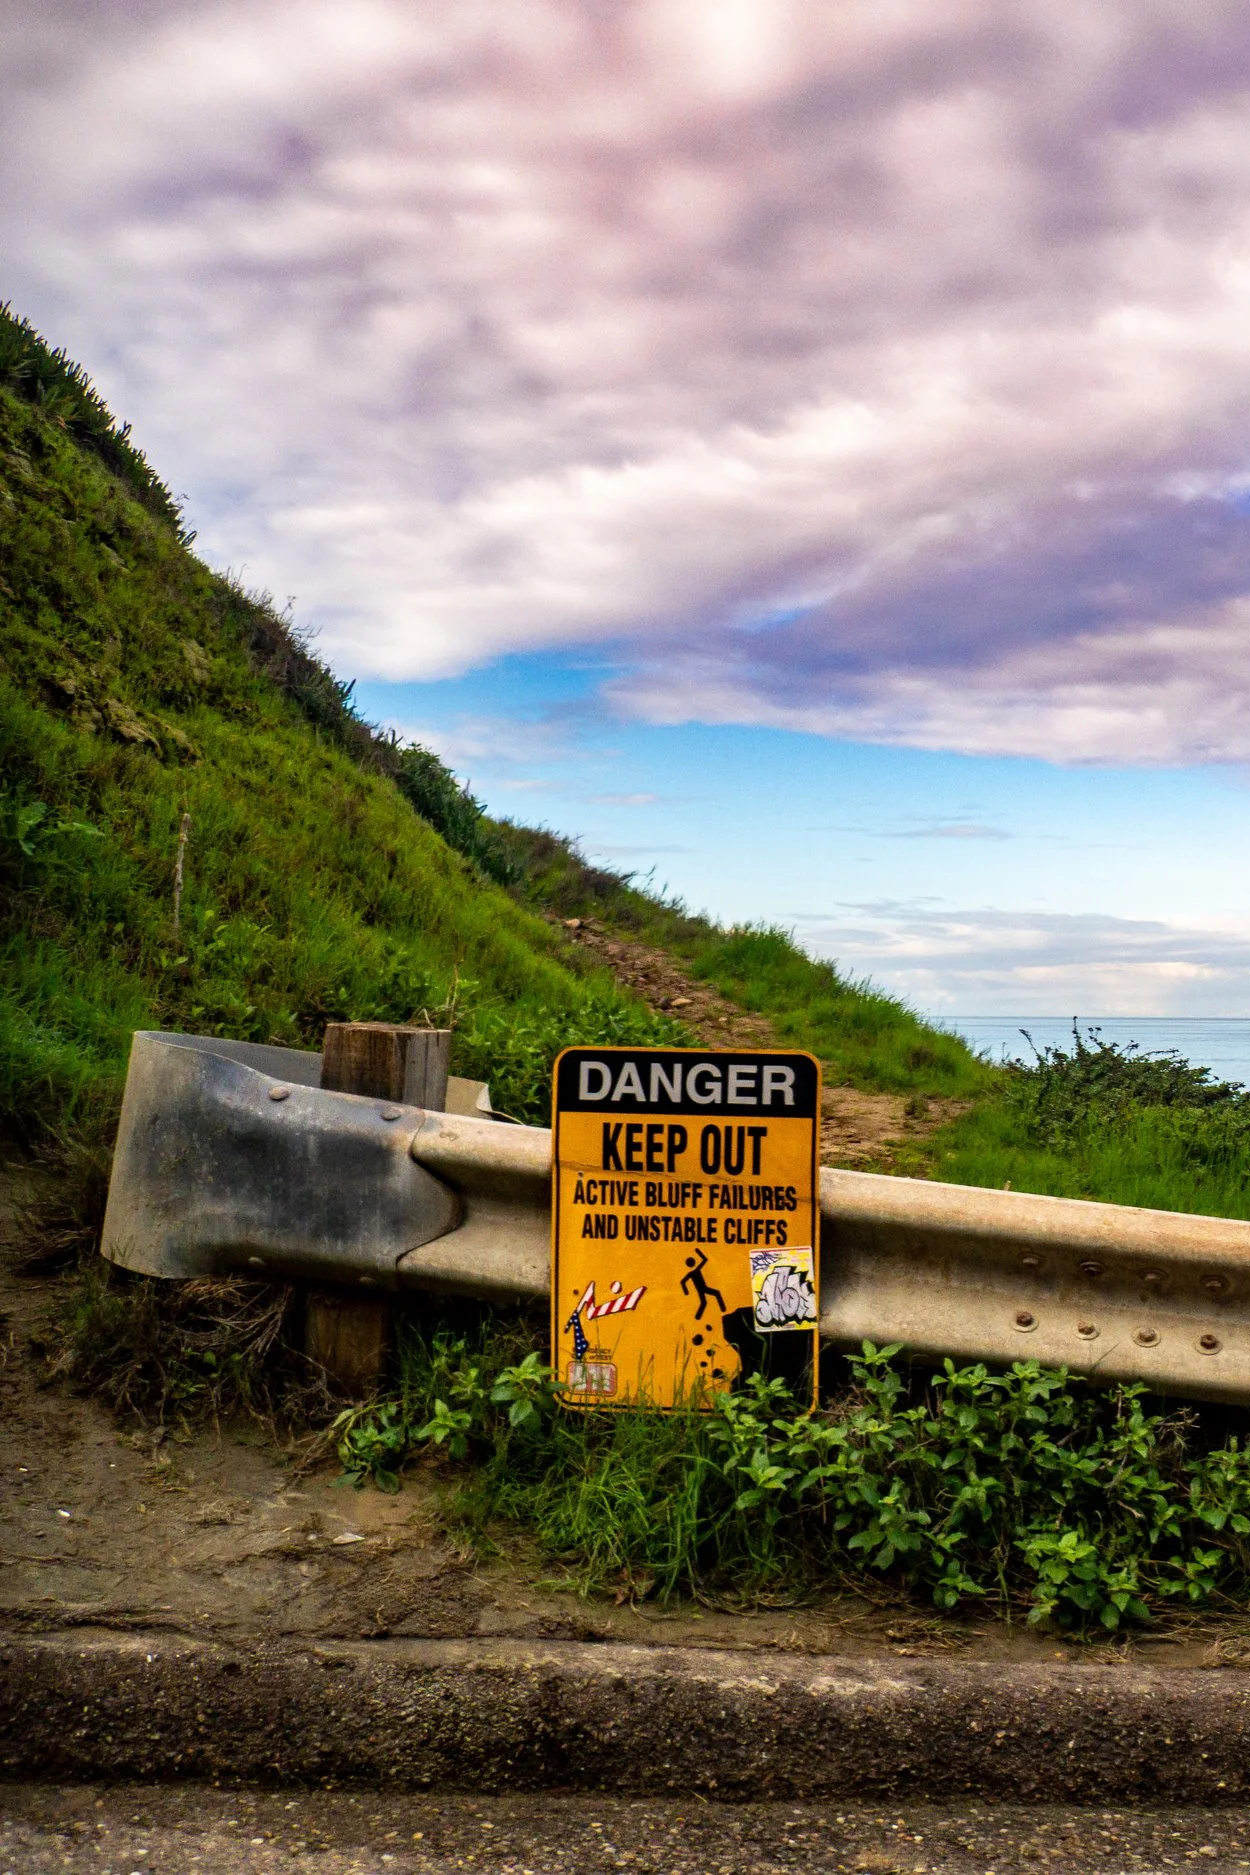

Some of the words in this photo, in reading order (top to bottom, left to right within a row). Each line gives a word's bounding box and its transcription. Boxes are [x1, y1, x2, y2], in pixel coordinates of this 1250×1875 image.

[579, 1061, 796, 1106] DANGER
[602, 1122, 688, 1173] KEEP
[700, 1124, 768, 1176] OUT
[573, 1179, 639, 1206] ACTIVE
[645, 1181, 703, 1208] BLUFF
[709, 1184, 797, 1212] FAILURES
[582, 1214, 618, 1240] AND
[625, 1214, 718, 1243] UNSTABLE
[724, 1218, 787, 1246] CLIFFS
